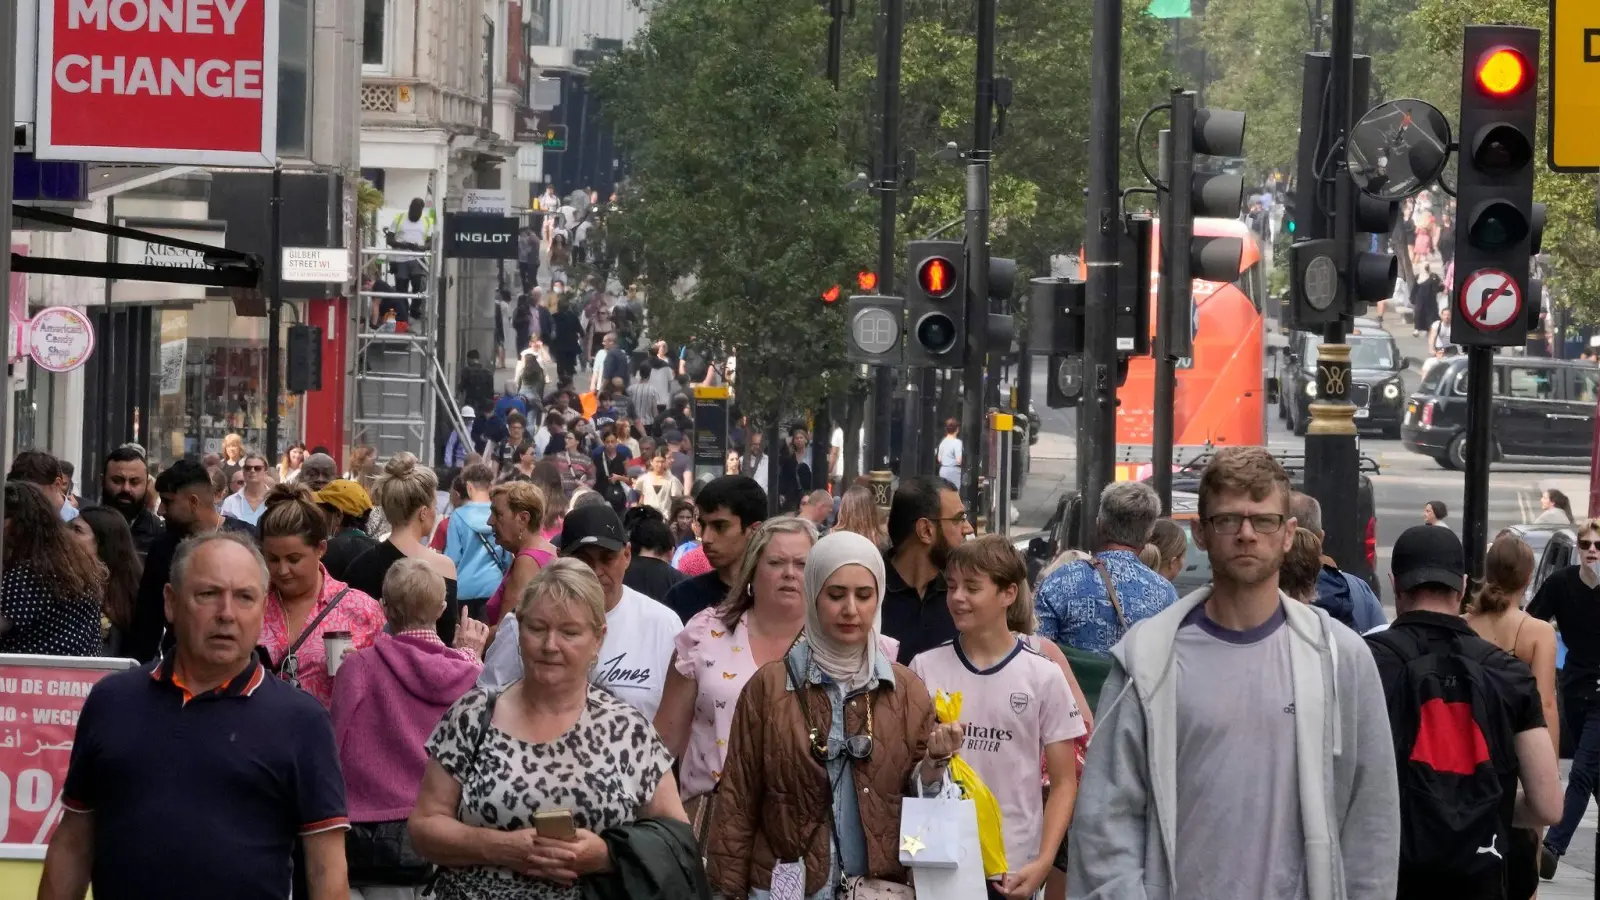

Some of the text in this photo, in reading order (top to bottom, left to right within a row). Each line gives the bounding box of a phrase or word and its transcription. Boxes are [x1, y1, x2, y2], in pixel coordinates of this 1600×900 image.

[68, 0, 249, 35] MONEY
[55, 54, 262, 99] CHANGE
[455, 233, 511, 243] INGLOT
[289, 250, 320, 259] GILBERT
[289, 260, 330, 269] STREET W1
[596, 652, 651, 684] Jones
[21, 678, 43, 695] DE
[967, 739, 1001, 752] BETTER
